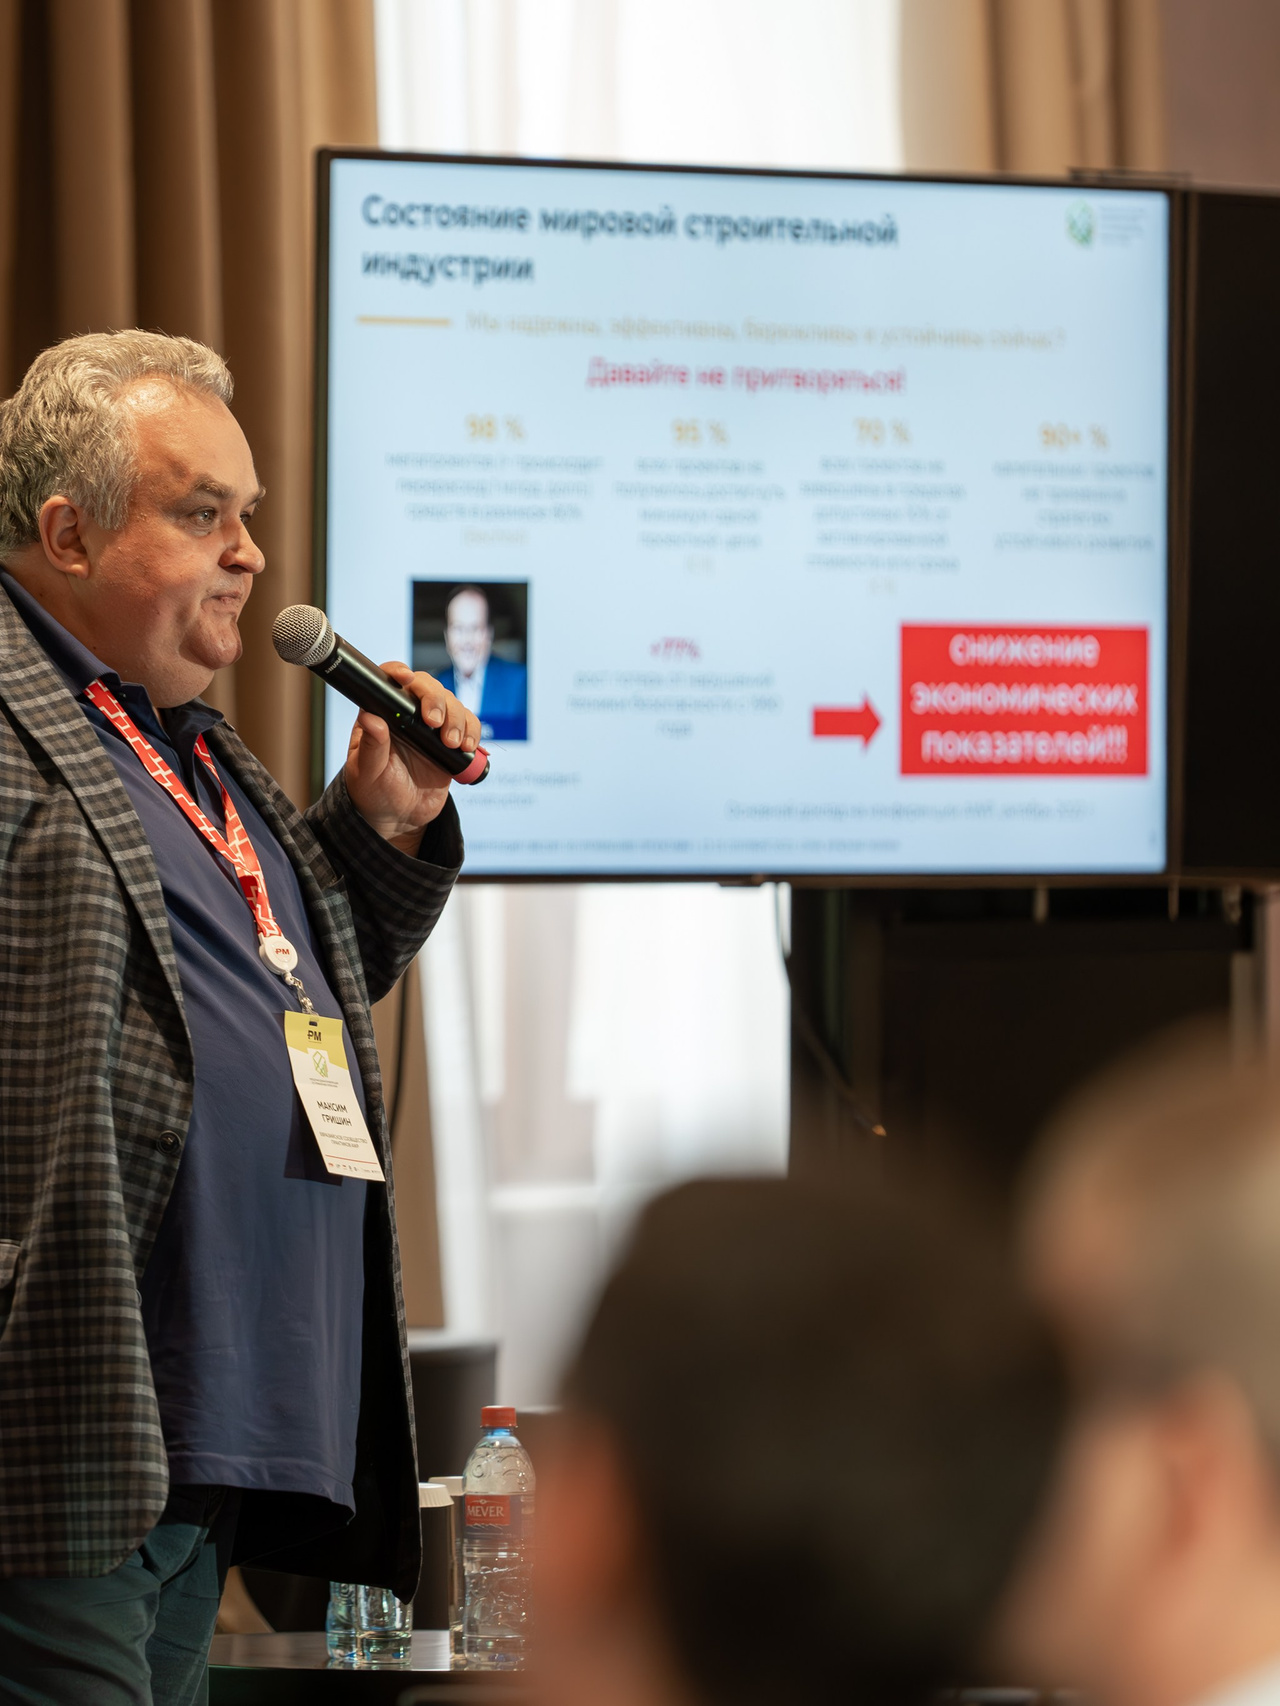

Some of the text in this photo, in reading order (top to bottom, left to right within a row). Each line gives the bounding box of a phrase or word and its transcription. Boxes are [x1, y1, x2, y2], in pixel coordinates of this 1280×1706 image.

[361, 193, 899, 249] Состояние мировой строительной
[361, 248, 534, 287] индустрии
[587, 356, 690, 391] Давайте
[695, 366, 728, 389] не
[317, 1100, 348, 1114] МАКСИМ
[322, 1113, 352, 1127] ГРИШИН
